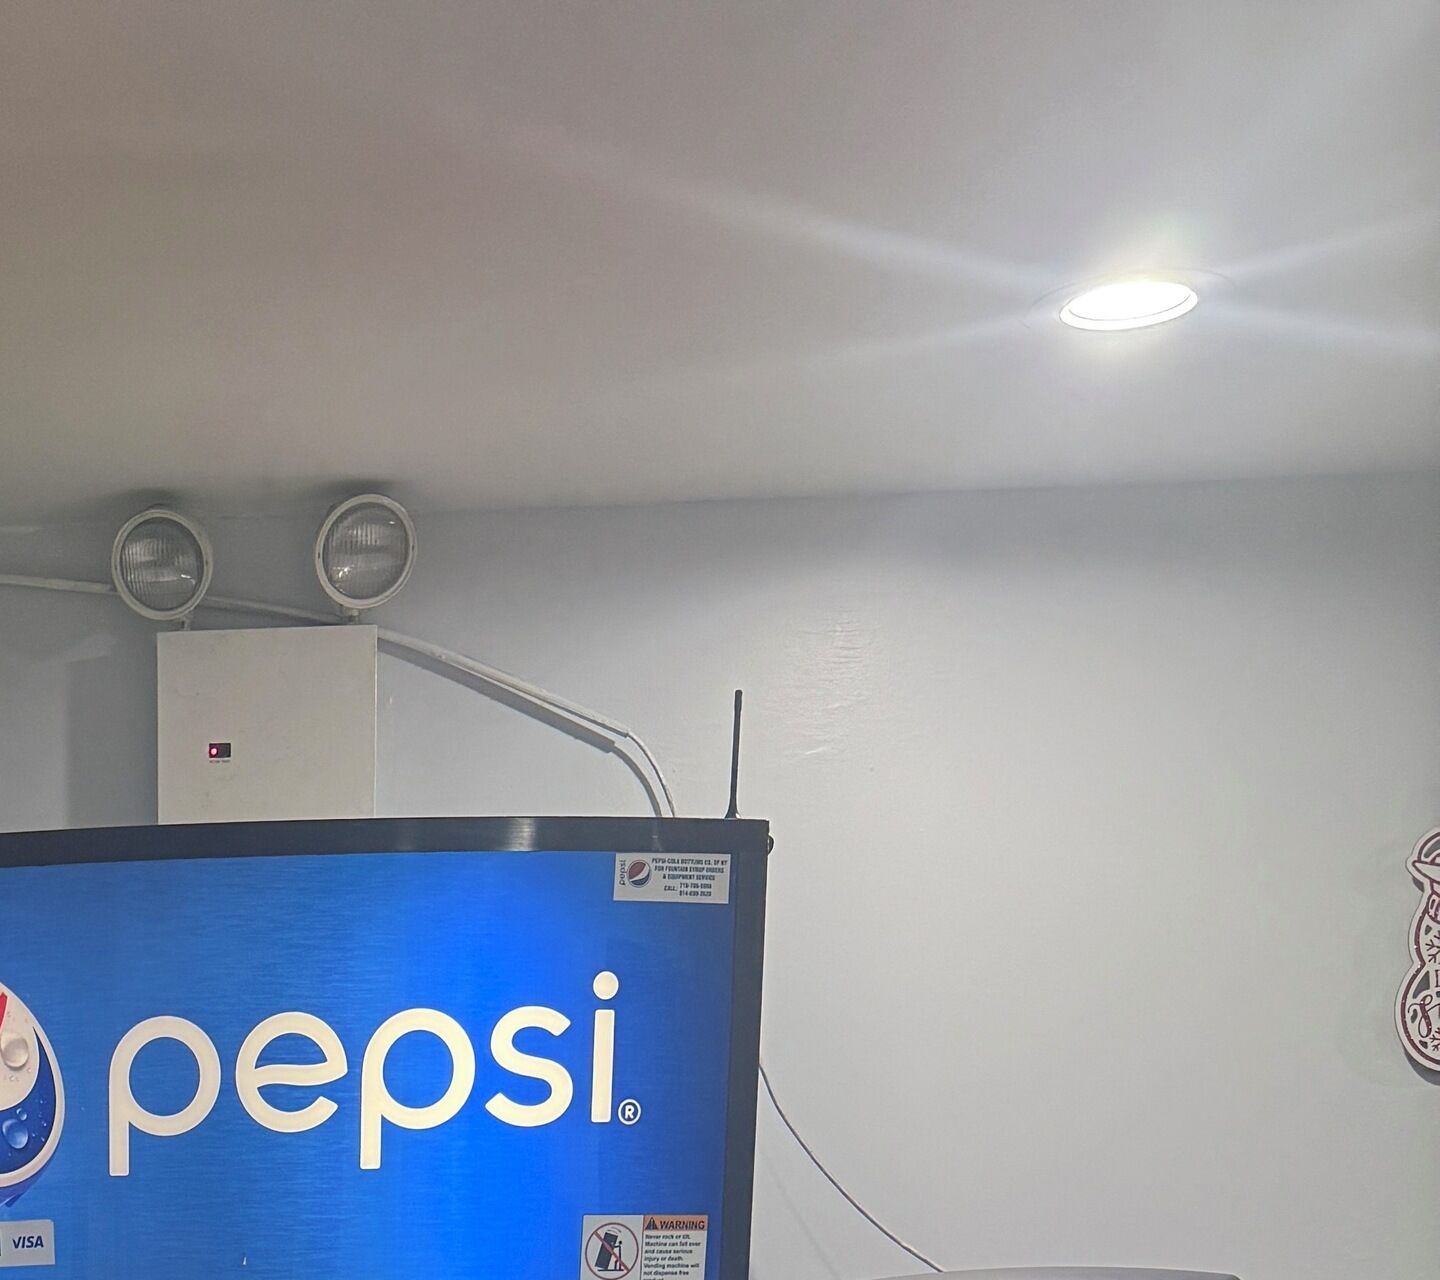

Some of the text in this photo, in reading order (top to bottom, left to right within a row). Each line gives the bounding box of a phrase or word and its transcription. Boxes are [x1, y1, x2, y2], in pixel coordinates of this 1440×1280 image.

[107, 971, 620, 1177] pepsi
[660, 1220, 705, 1230] WARNING
[13, 1236, 44, 1249] VISA
